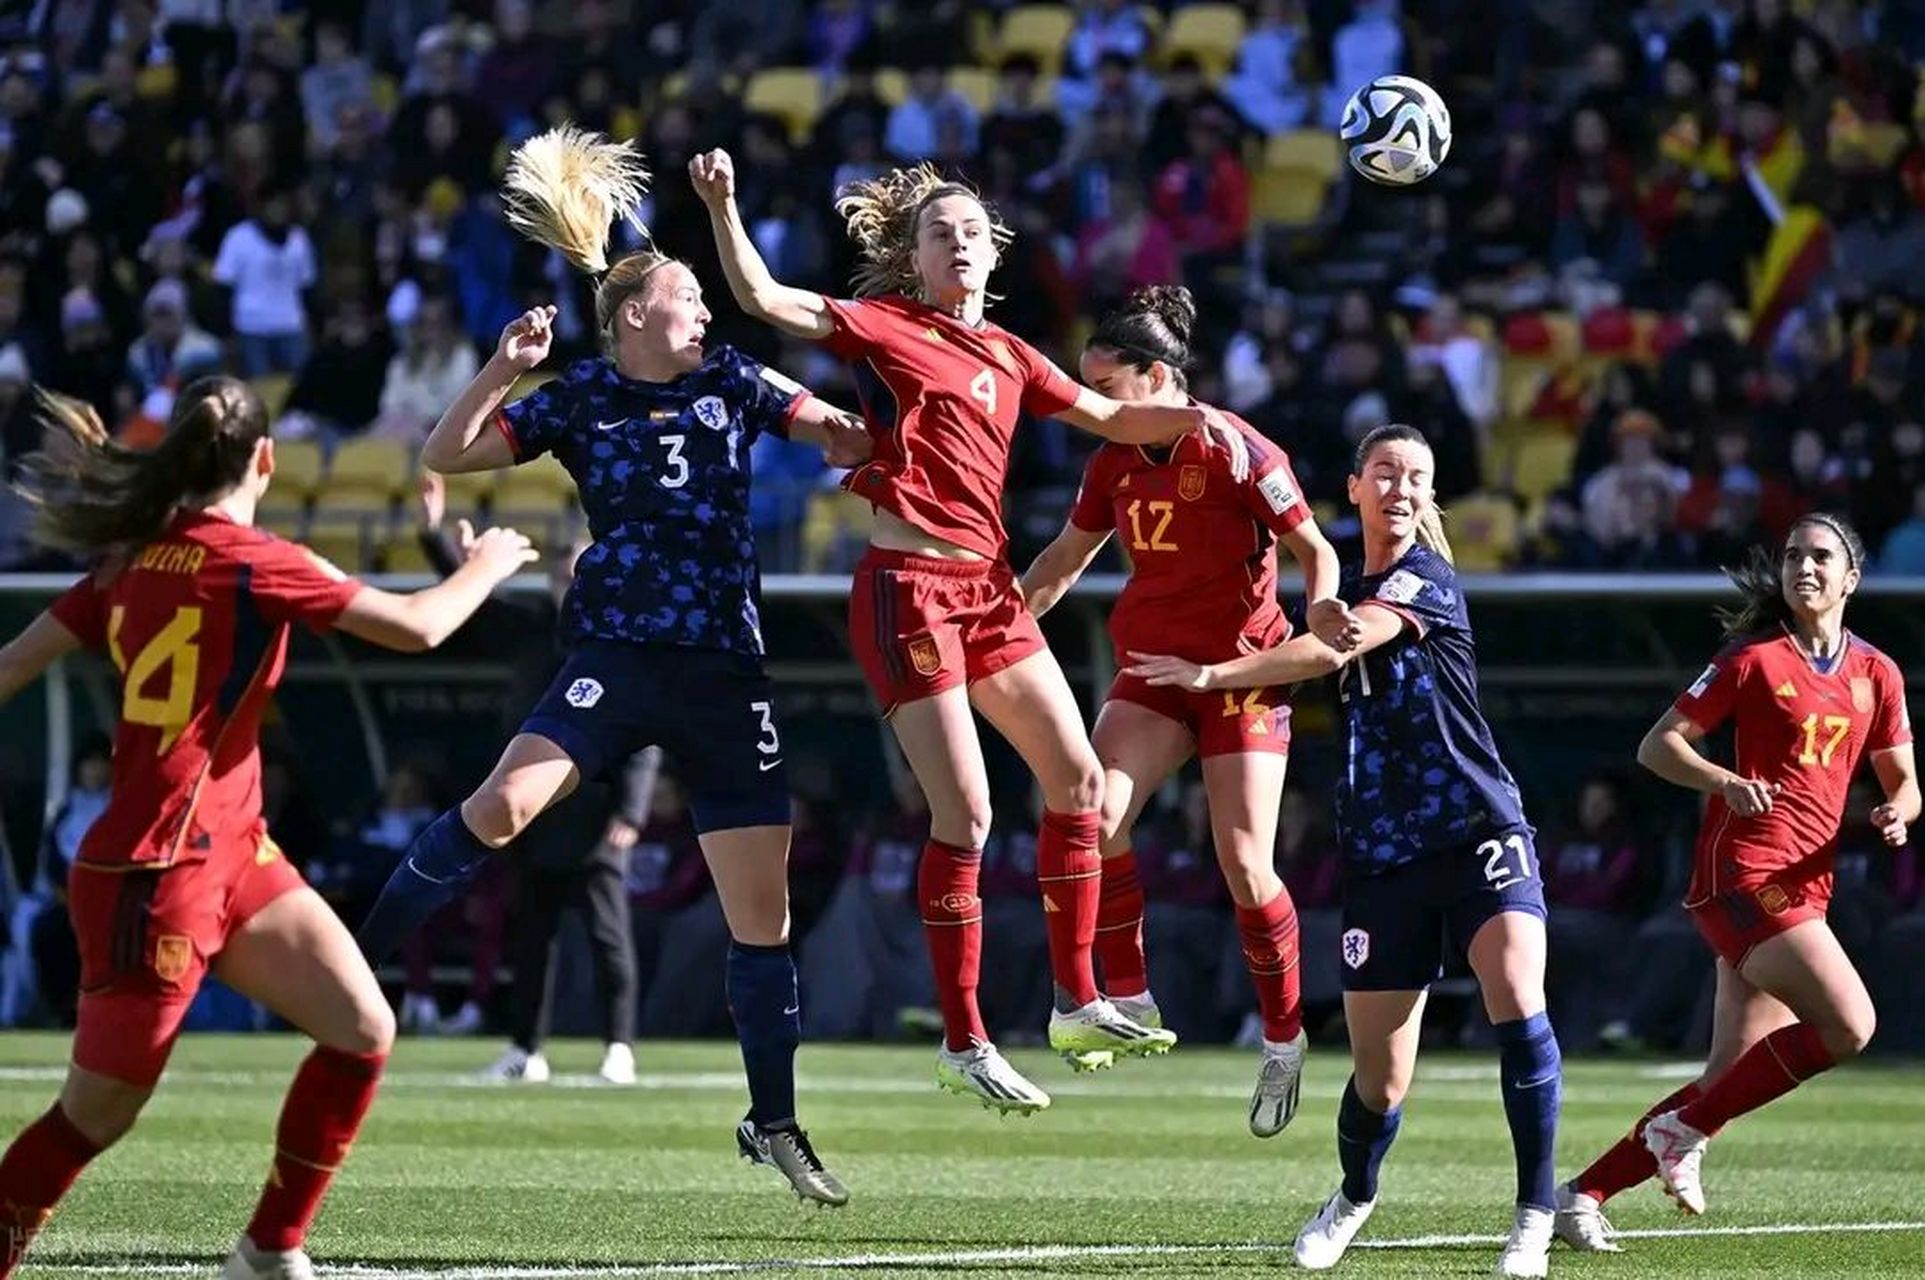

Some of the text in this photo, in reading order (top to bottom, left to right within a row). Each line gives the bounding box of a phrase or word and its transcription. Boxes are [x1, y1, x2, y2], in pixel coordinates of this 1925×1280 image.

[659, 434, 689, 488] 3
[1127, 499, 1179, 551] 12
[107, 605, 203, 757] 14
[1222, 685, 1270, 717] 12
[751, 701, 779, 753] 3
[1798, 713, 1851, 767] 17
[1476, 834, 1531, 881] 21
